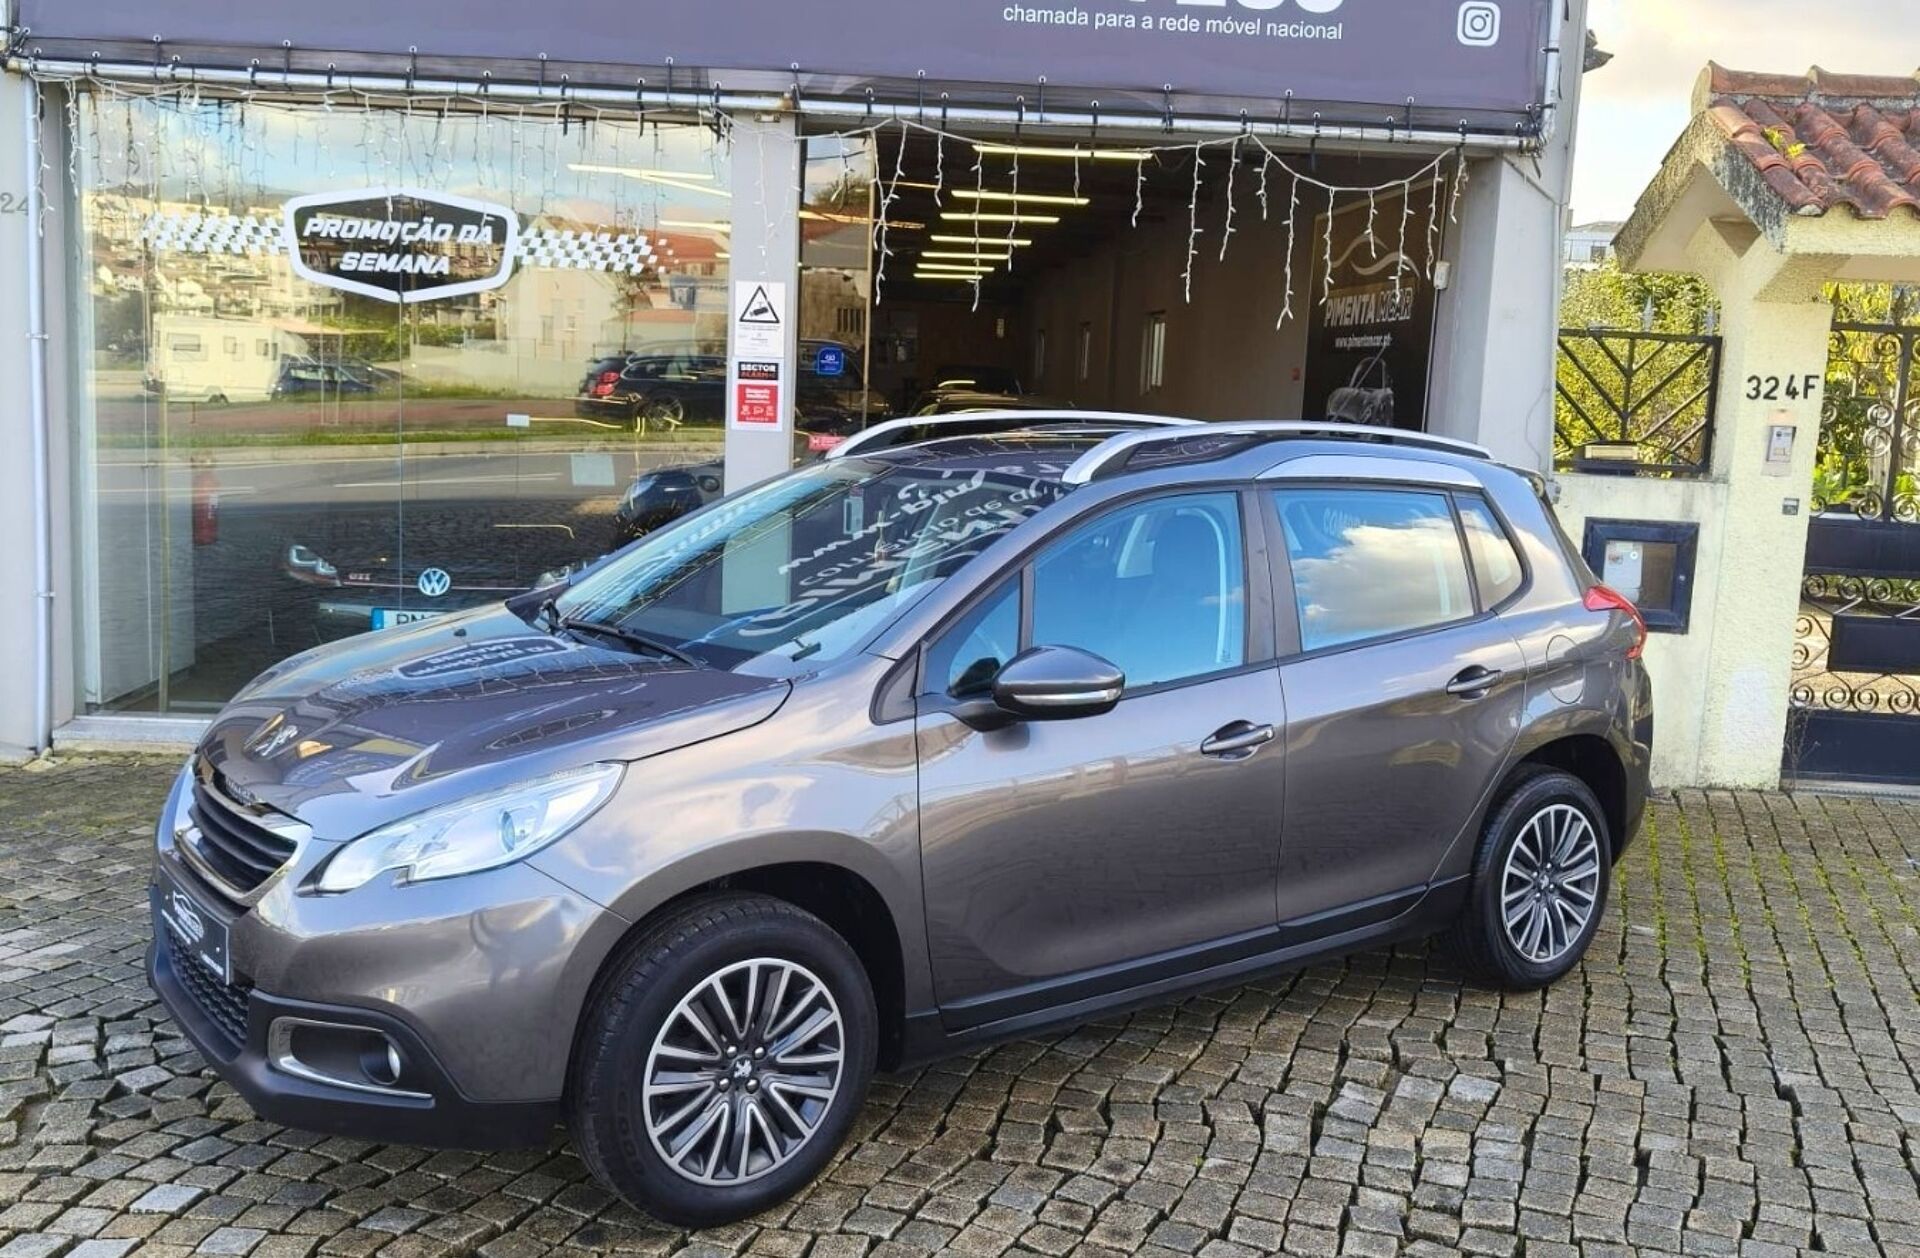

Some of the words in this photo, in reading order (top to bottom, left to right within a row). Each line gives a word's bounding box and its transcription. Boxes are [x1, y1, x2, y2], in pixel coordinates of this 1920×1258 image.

[1003, 4, 1089, 26] chamada
[1094, 11, 1136, 30] para
[1141, 15, 1153, 30] a
[1159, 14, 1200, 32] rede
[1206, 16, 1261, 36] móvel
[1266, 21, 1343, 40] nacional
[303, 217, 453, 245] PROMOÇÃO
[457, 224, 493, 245] DA
[340, 251, 450, 275] SEMANA
[1746, 374, 1819, 400] 324F
